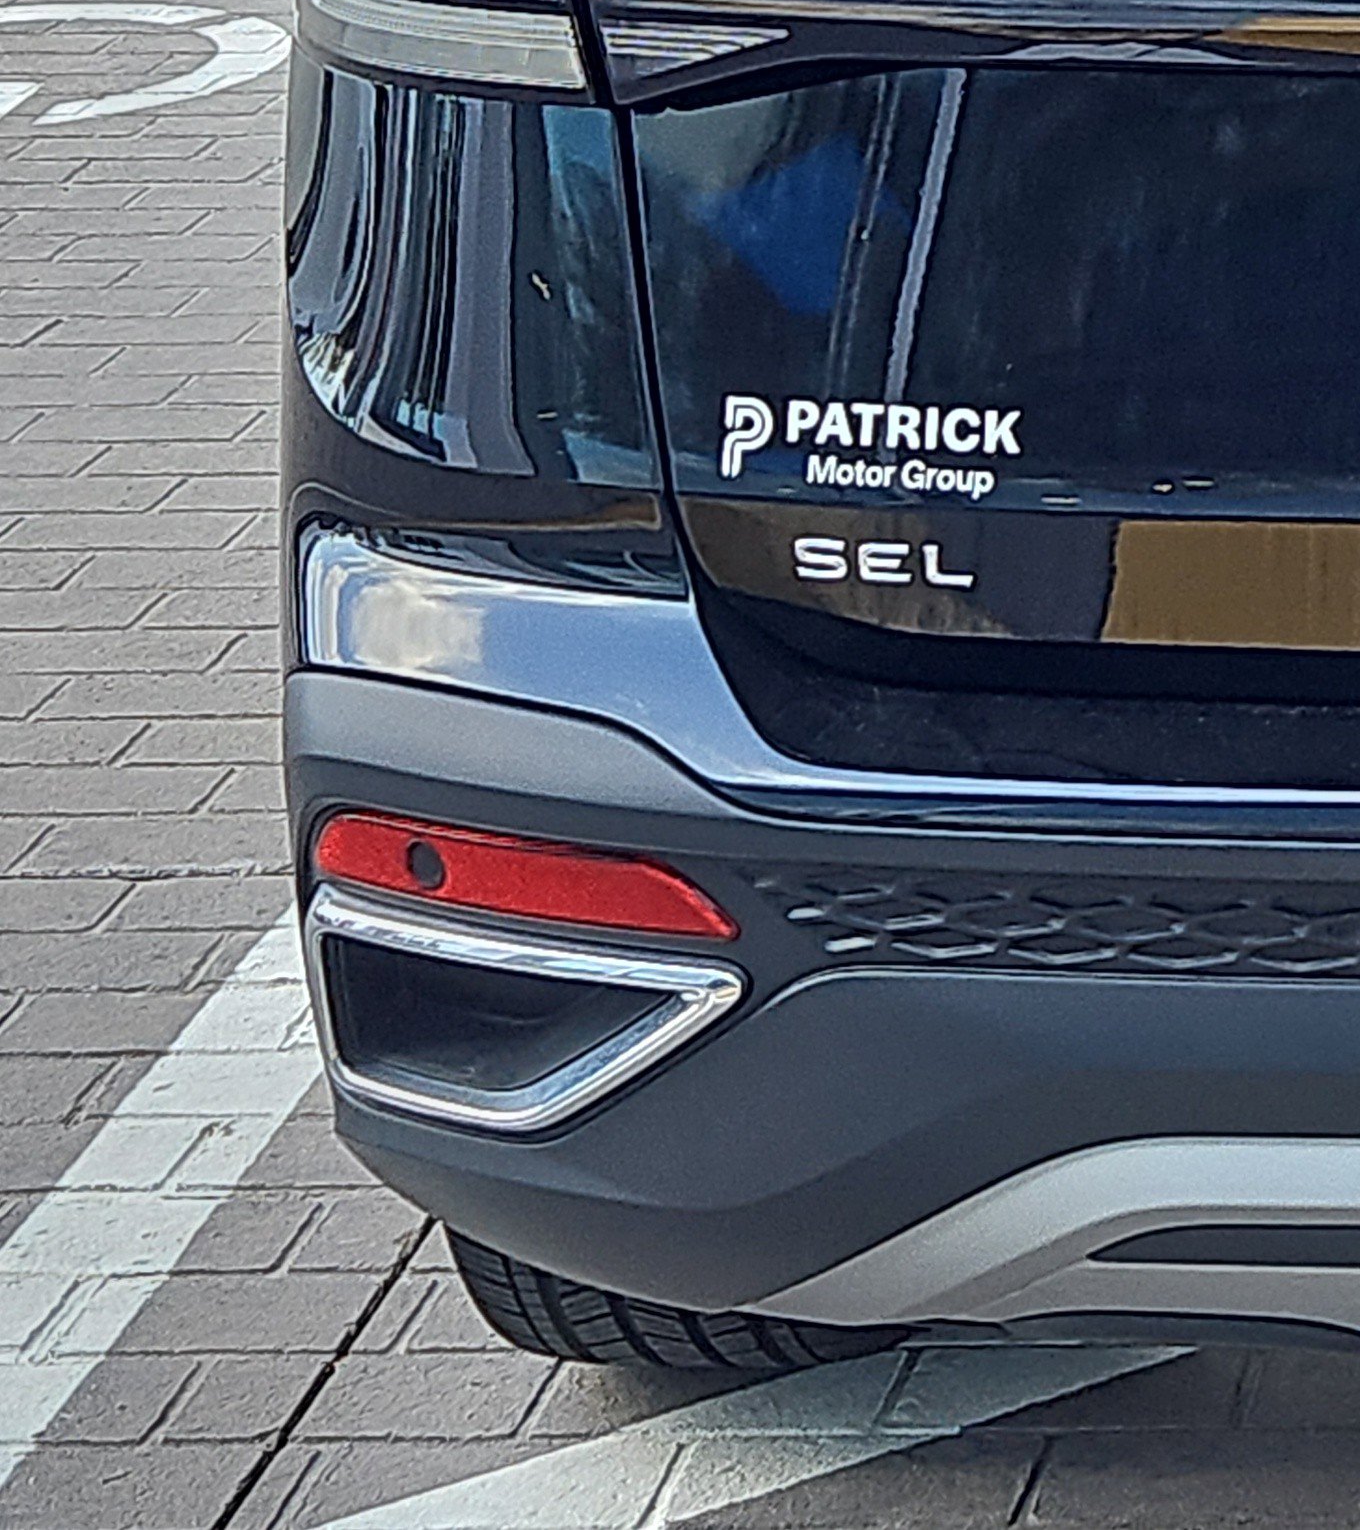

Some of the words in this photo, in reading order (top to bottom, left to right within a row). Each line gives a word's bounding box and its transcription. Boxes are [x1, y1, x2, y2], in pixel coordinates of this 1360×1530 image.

[785, 399, 1021, 455] PATRICK
[806, 454, 898, 488] Motor
[900, 459, 995, 501] Group
[793, 537, 975, 588] SEL
